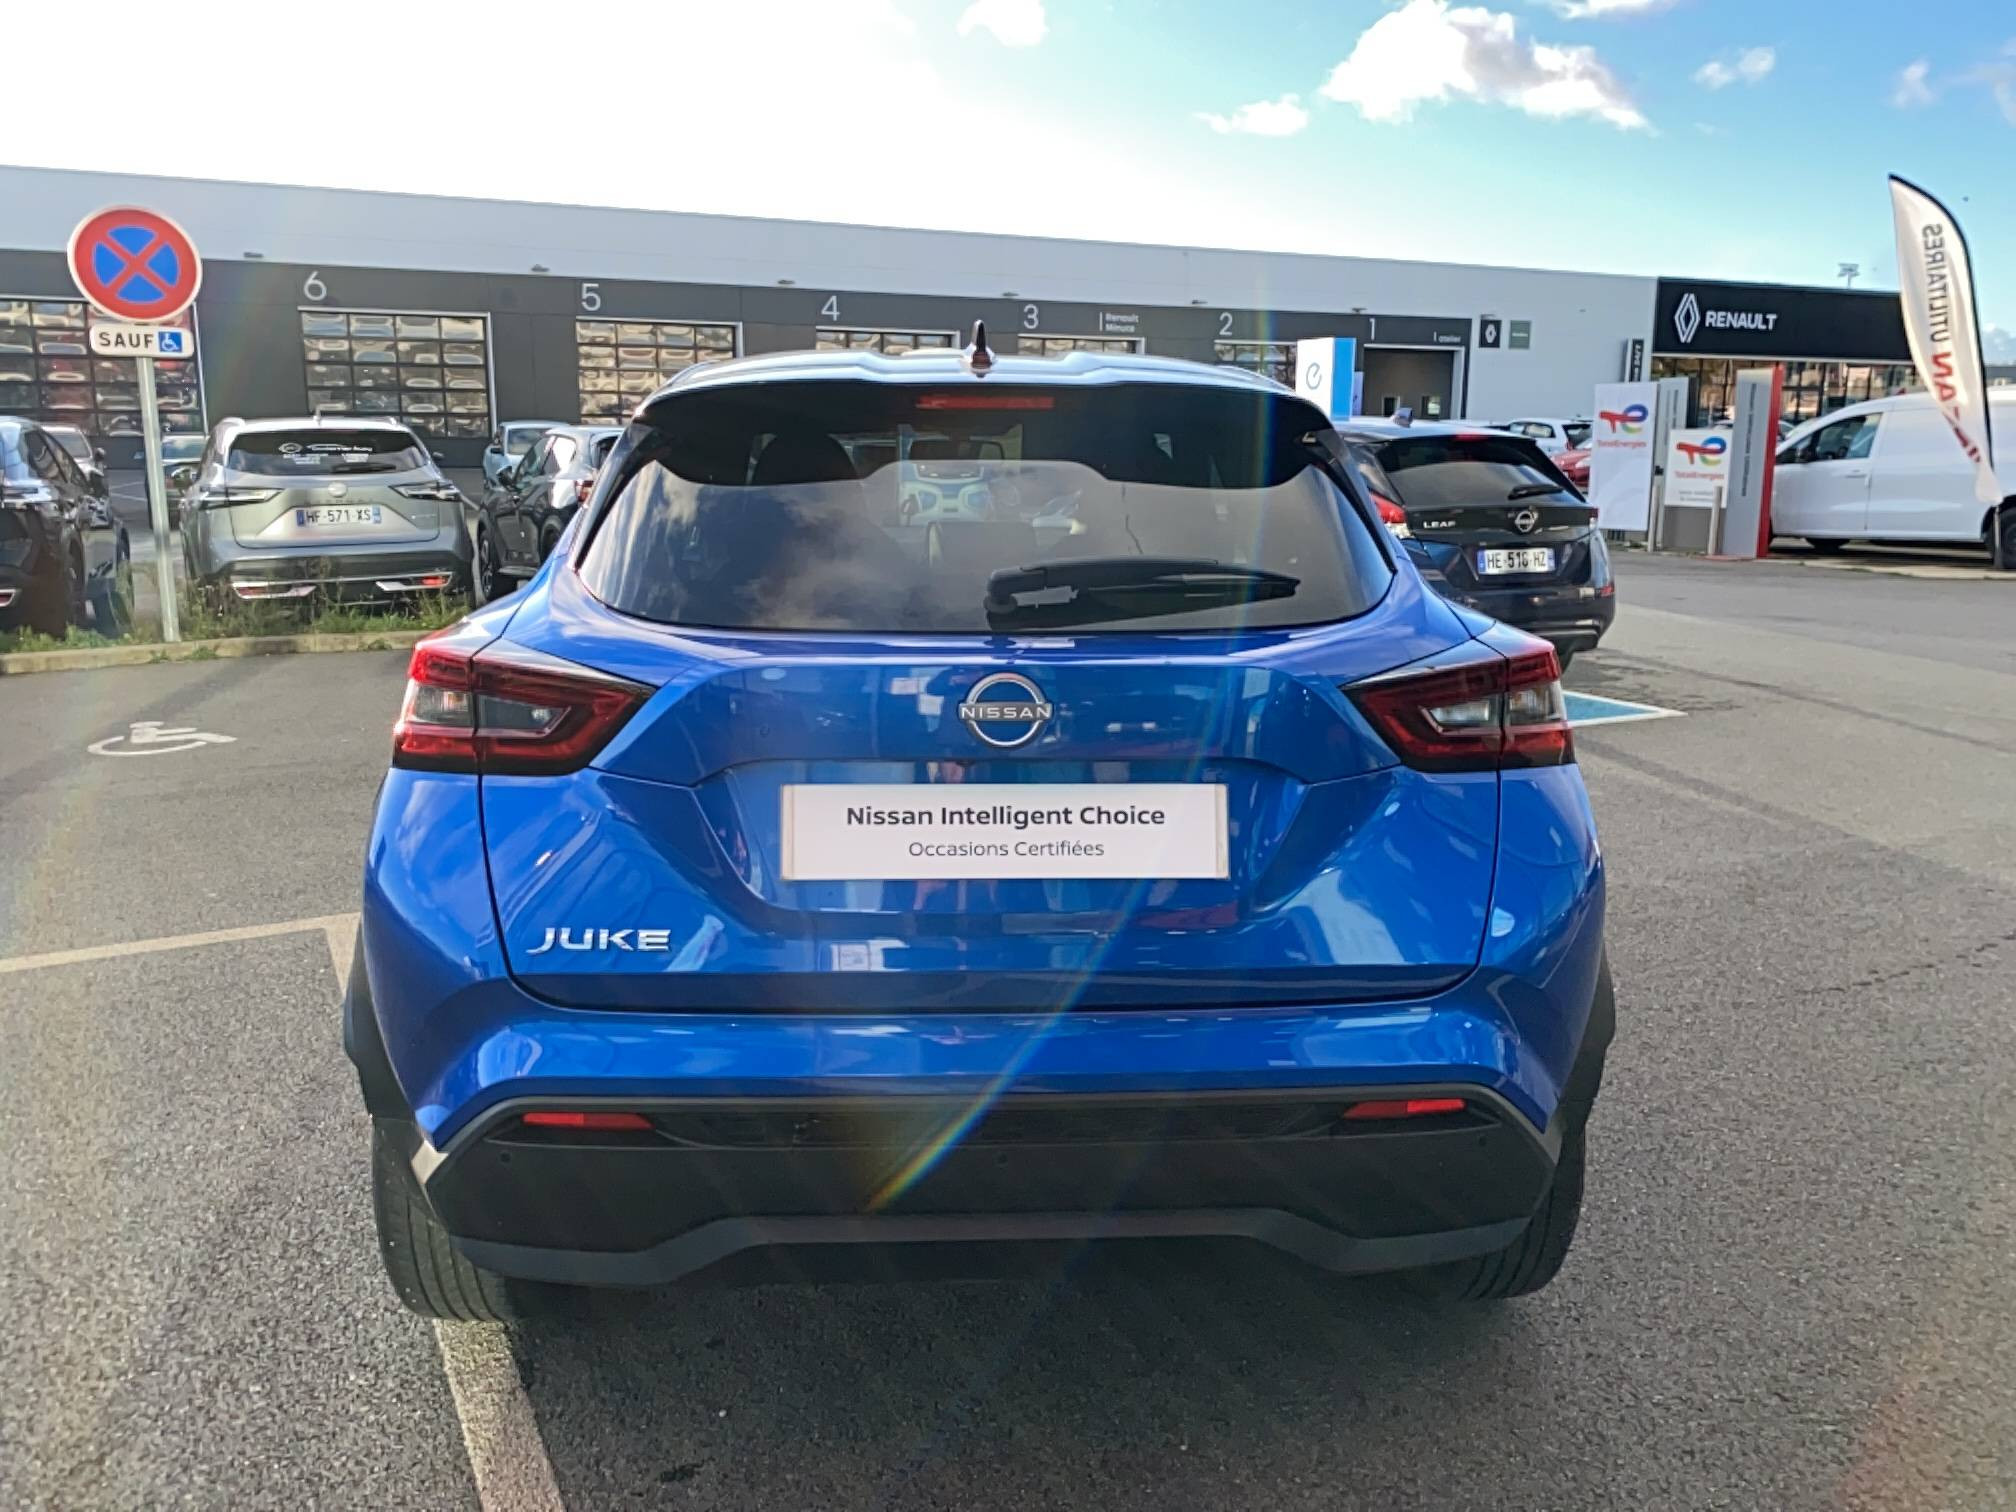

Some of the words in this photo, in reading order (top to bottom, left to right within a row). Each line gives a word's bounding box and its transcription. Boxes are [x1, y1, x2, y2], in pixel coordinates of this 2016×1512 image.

[302, 271, 327, 301] 6
[580, 282, 601, 311] 5
[820, 295, 840, 321] 4
[1023, 303, 1039, 329] 3
[1704, 309, 1777, 330] RENAULT
[1219, 311, 1233, 336] 2
[1369, 317, 1376, 341] 1
[98, 331, 154, 348] SAUF
[1423, 520, 1456, 529] LEAF
[961, 707, 1051, 720] NISSAN
[846, 806, 933, 825] Nissan
[941, 806, 1073, 830] Intelligent
[1080, 805, 1166, 825] Choice
[908, 841, 1009, 857] Occasions
[1014, 839, 1105, 857] Certifiées
[525, 927, 672, 954] JUKE
